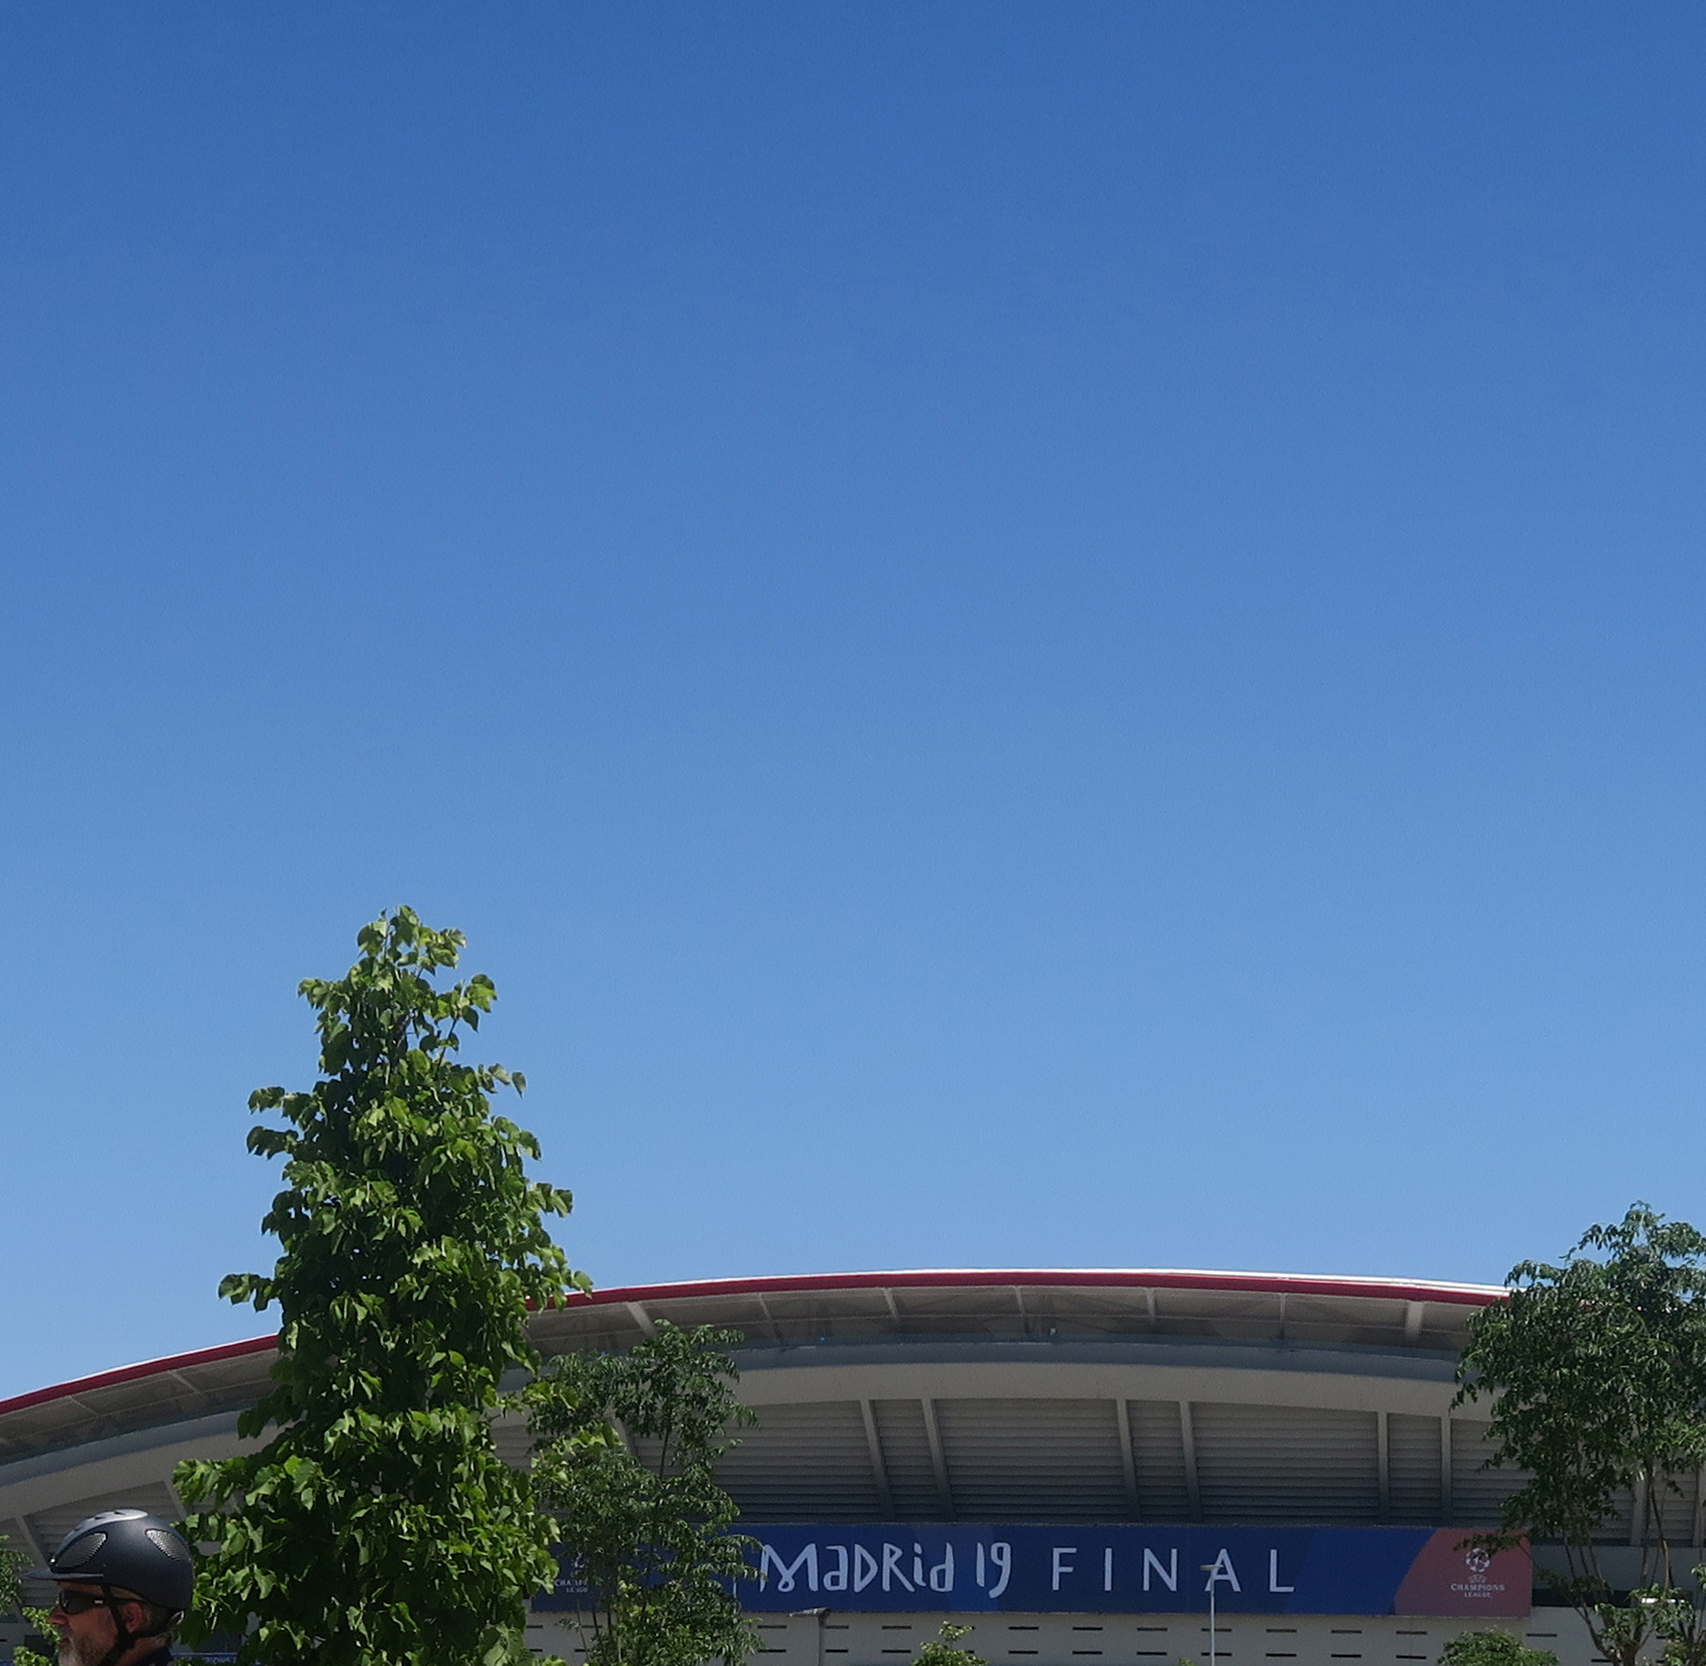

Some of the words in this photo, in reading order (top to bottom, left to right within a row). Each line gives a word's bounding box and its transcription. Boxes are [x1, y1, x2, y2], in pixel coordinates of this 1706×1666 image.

[975, 1541, 1012, 1598] 19
[1051, 1546, 1296, 1593] FINAL
[1451, 1583, 1505, 1591] CHAMPIONS
